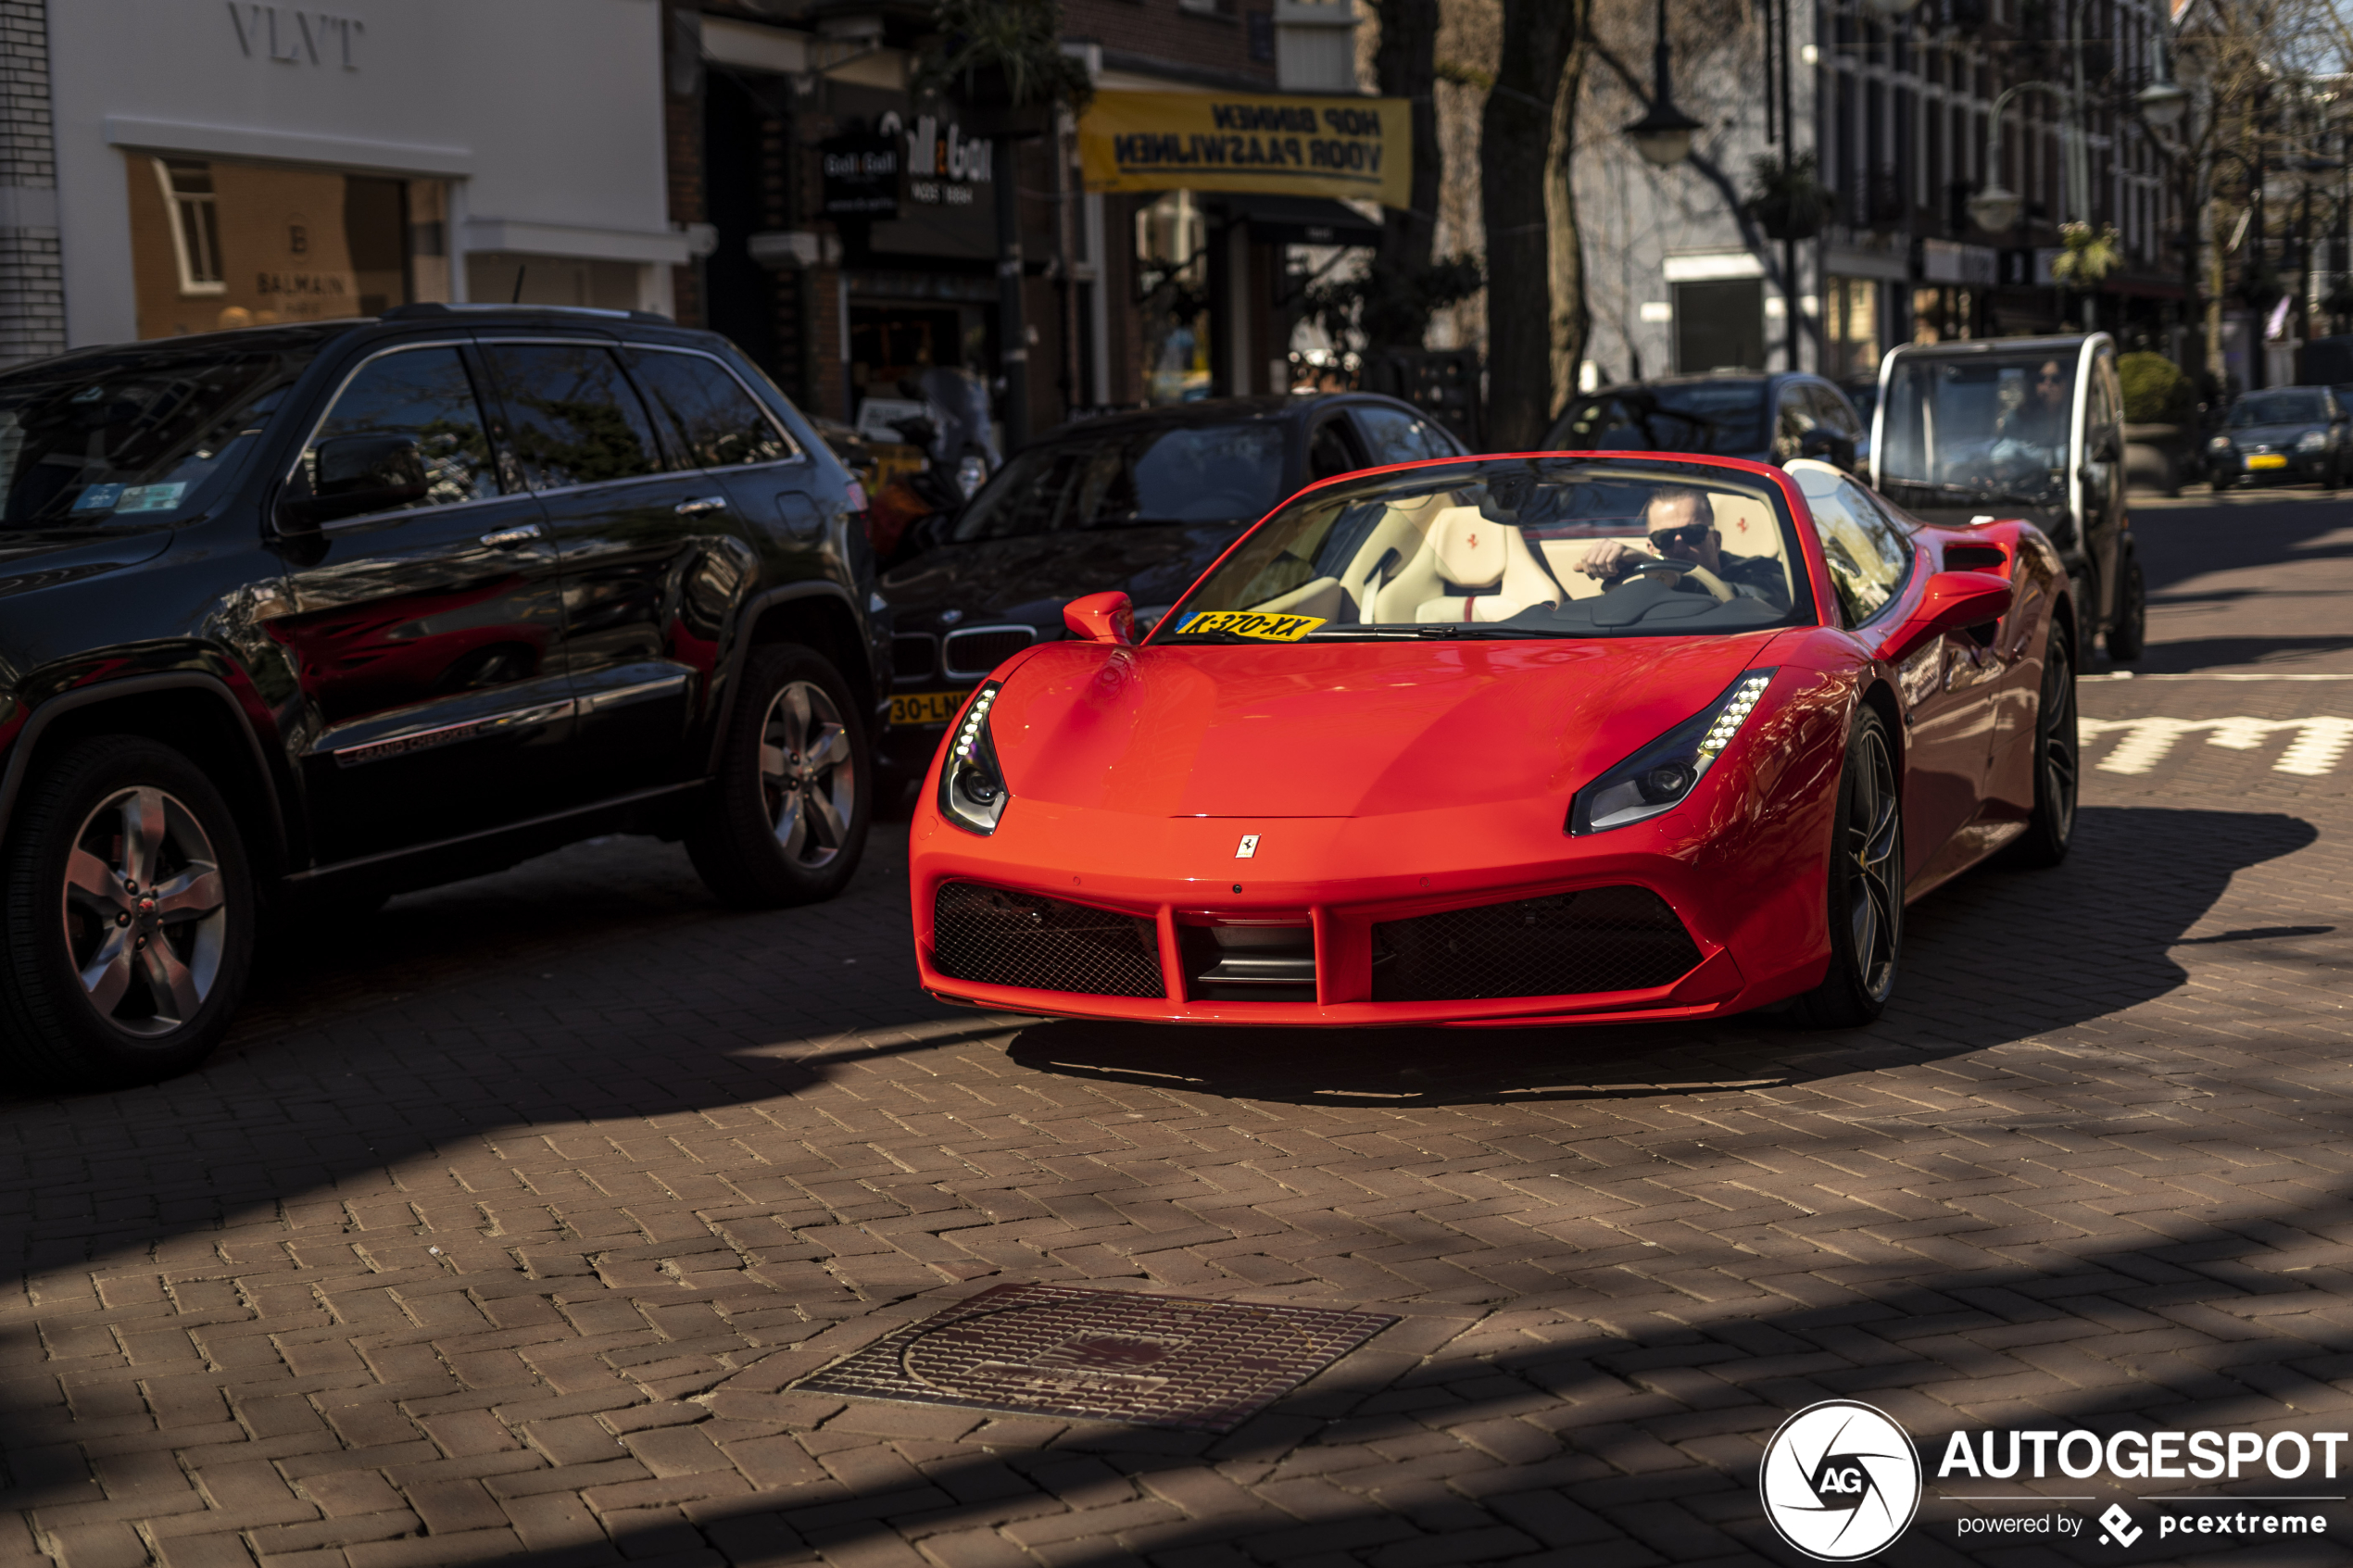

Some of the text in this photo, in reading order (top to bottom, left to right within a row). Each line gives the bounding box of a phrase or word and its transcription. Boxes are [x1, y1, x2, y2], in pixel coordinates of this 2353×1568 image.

[228, 1, 366, 73] VLVT
[257, 272, 346, 295] BALMAIN
[1187, 613, 1311, 637] K-370-XX
[893, 695, 965, 721] 30-LN
[356, 725, 478, 760] GRAND CHEROKEE
